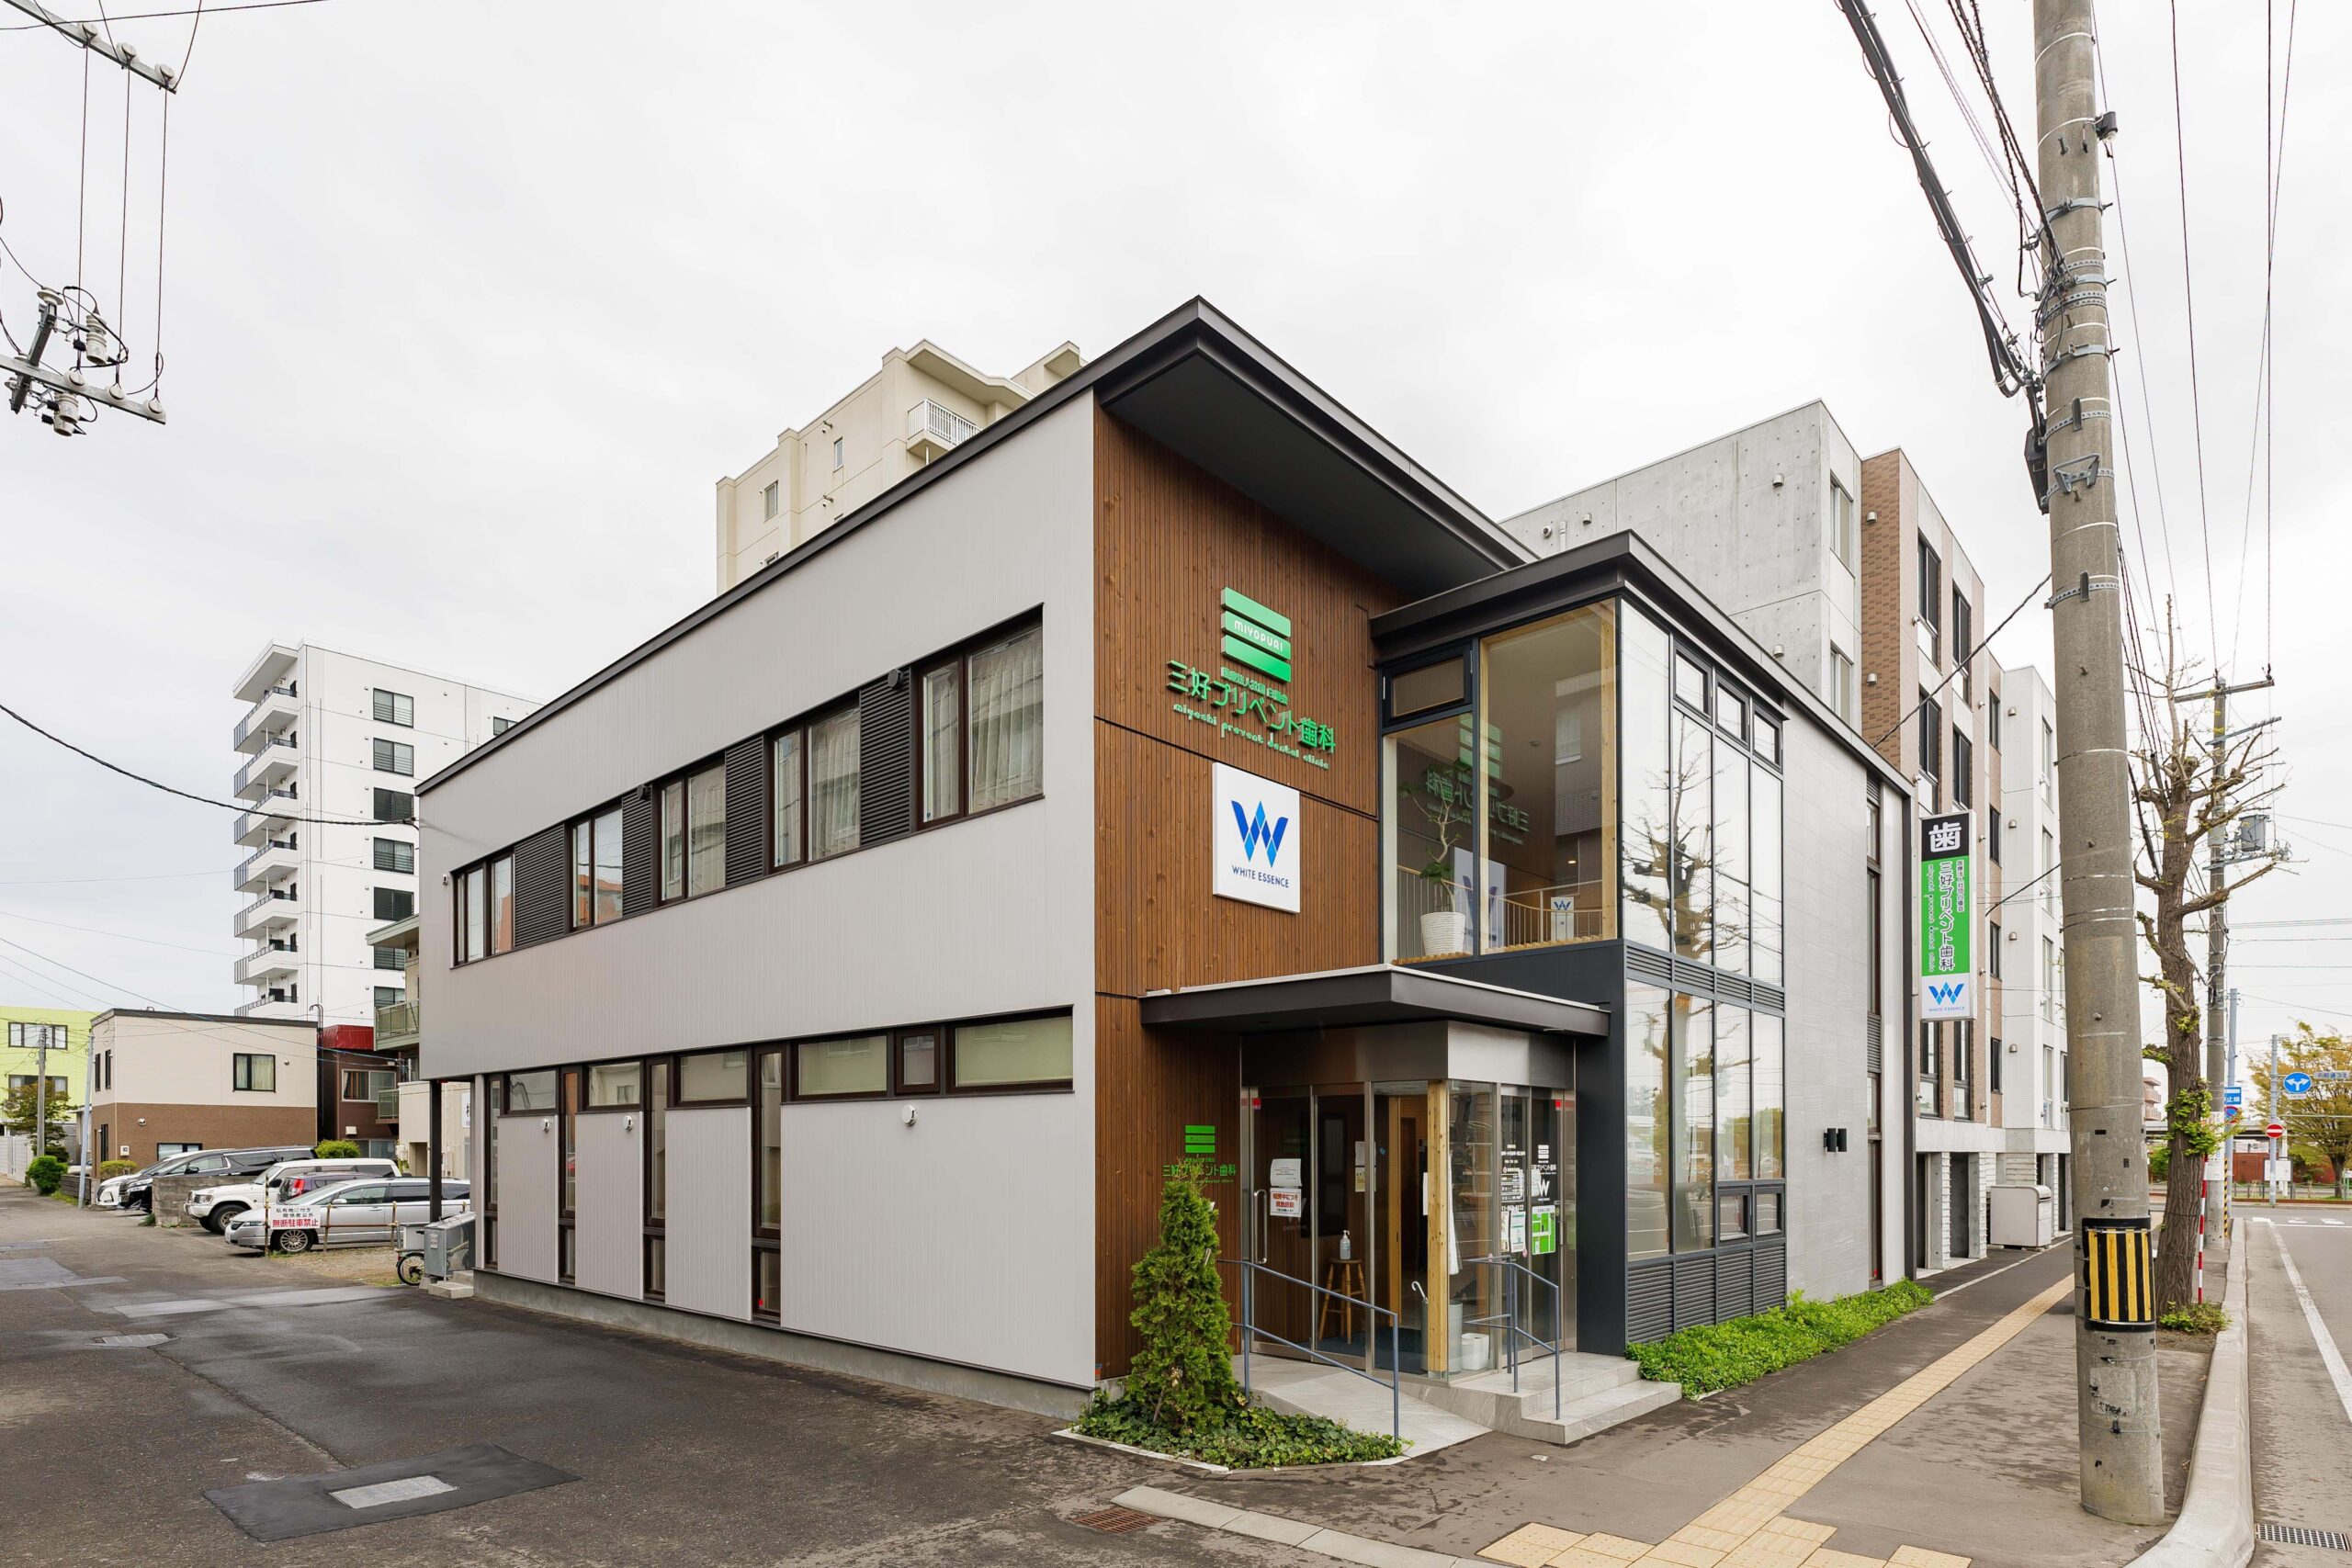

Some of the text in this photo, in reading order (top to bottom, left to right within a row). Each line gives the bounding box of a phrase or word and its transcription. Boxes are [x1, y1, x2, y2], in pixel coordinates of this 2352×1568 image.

[1234, 619, 1283, 652] MIYOPURI
[1166, 660, 1336, 754] 三好プリベント歯科
[1173, 703, 1329, 770] miyoshi prevent dental clinic
[1928, 822, 1962, 852] 歯
[1232, 865, 1289, 888] WHITE ESSENCE
[1939, 862, 1954, 971] 三好プリベント歯科
[273, 1218, 318, 1227] 無断駐車禁止
